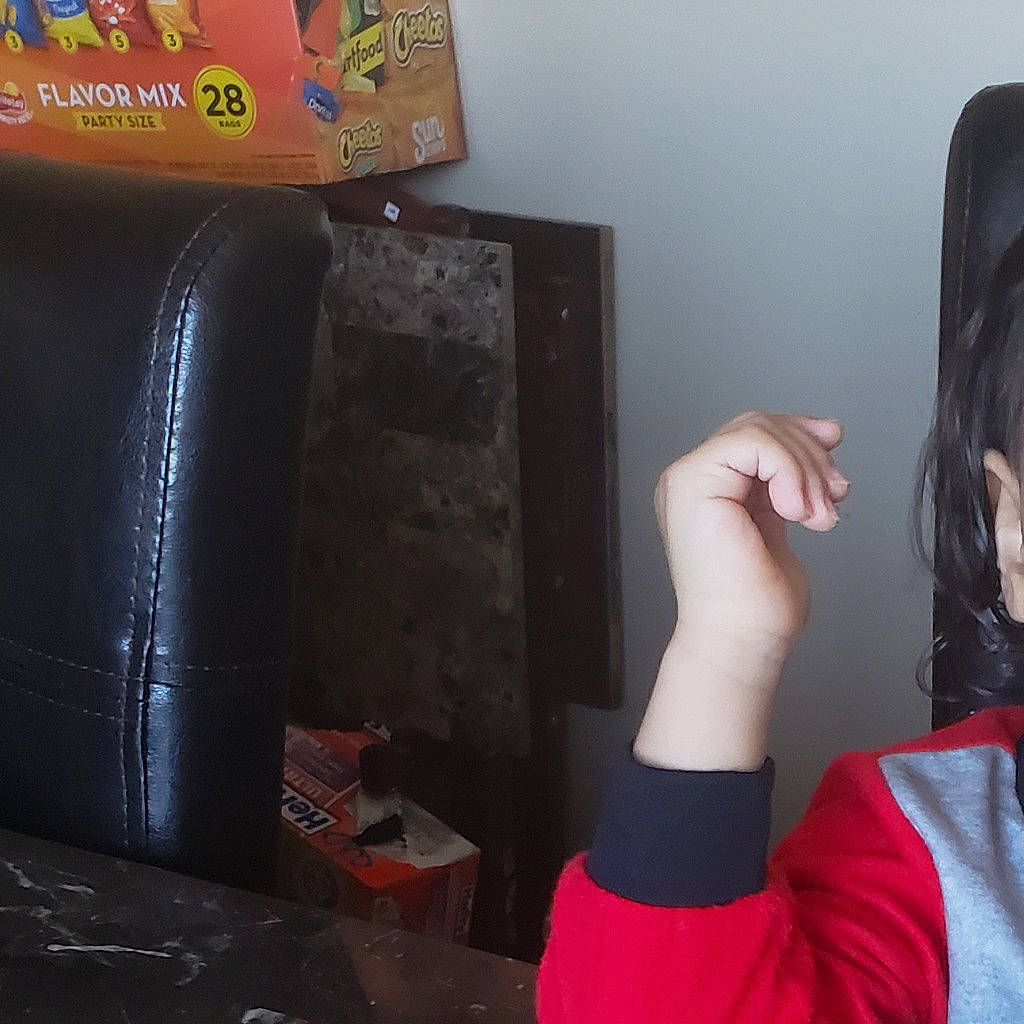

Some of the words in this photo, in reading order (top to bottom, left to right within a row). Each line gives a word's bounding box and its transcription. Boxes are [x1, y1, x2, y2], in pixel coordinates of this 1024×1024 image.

[10, 35, 19, 48] 3
[66, 36, 73, 49] 3
[115, 35, 124, 48] 5
[168, 34, 177, 47] 3
[343, 32, 383, 73] rtfood
[36, 83, 134, 108] FLAVOR
[137, 83, 187, 108] MIX
[202, 84, 246, 116] 28
[82, 115, 123, 127] PARTY
[127, 115, 157, 128] SIZE
